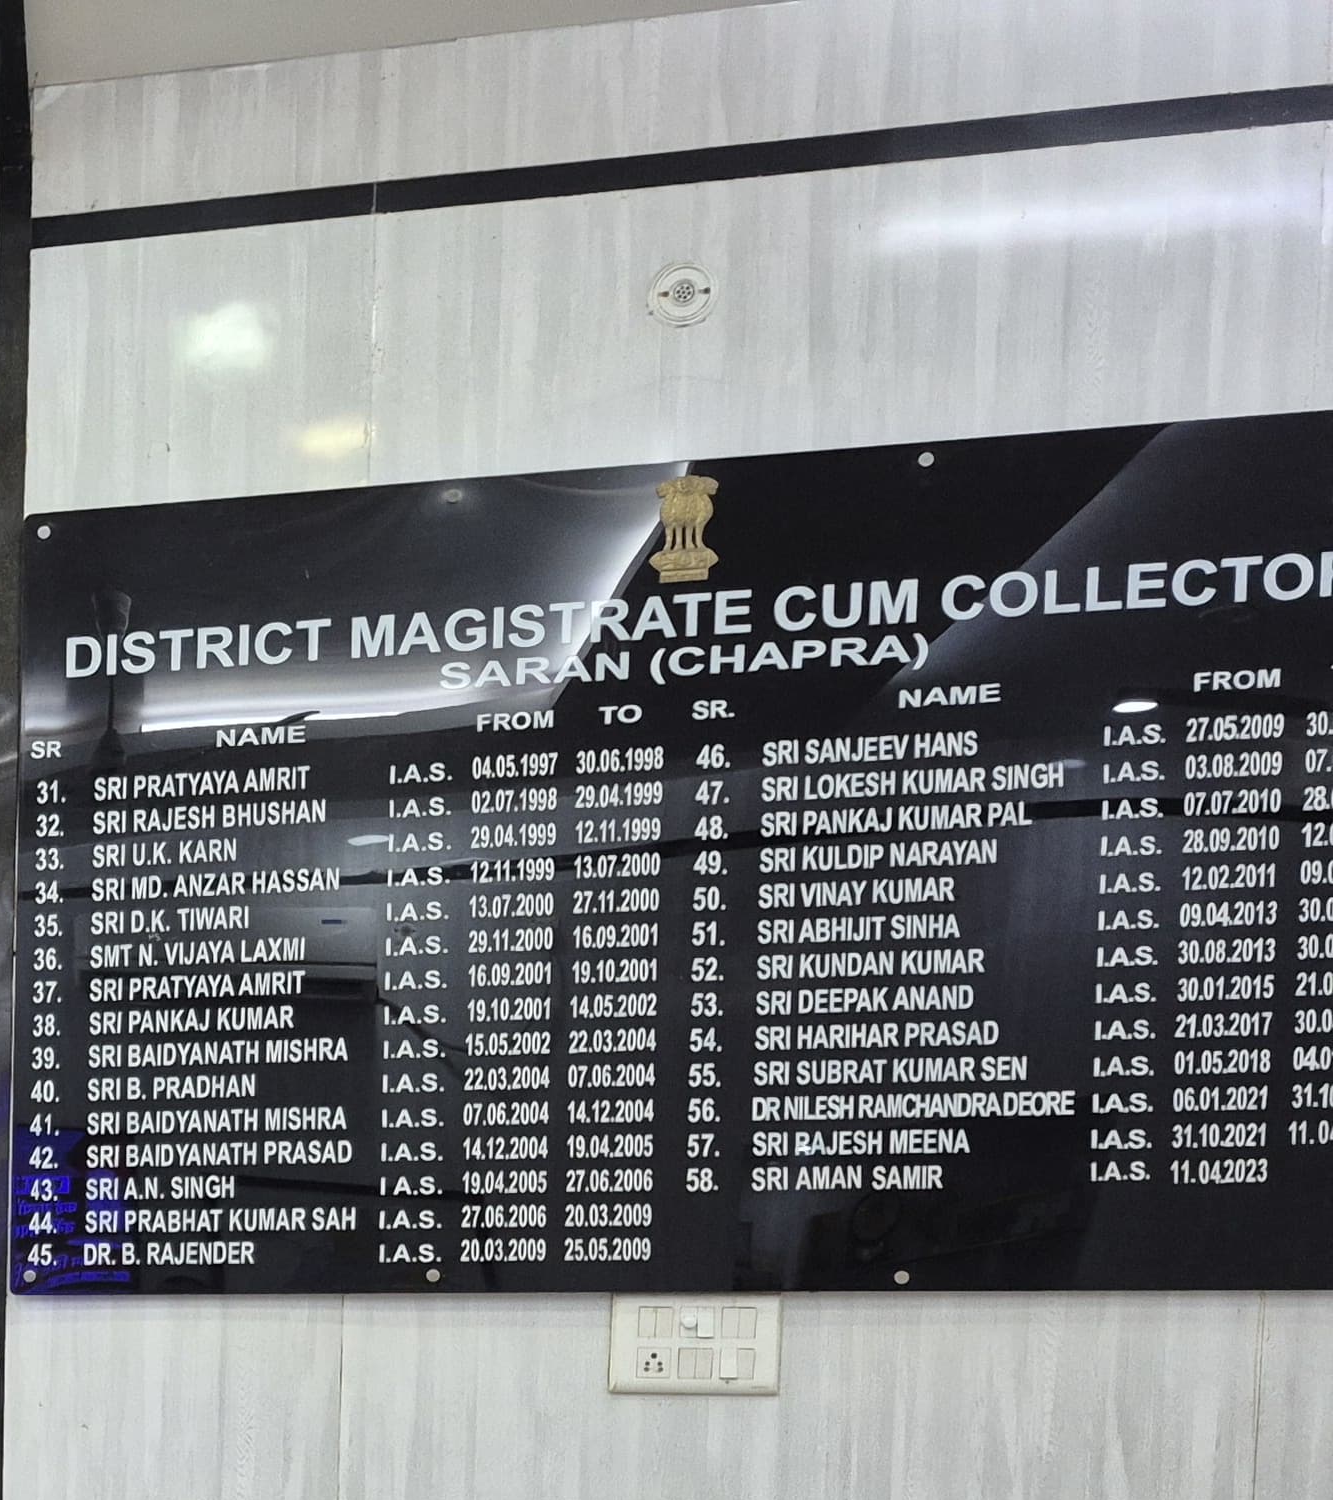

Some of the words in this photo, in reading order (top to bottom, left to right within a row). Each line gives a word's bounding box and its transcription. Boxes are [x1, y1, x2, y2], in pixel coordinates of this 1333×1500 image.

[65, 618, 331, 678] DISTRICT
[351, 589, 752, 660] MAGISTRATE
[774, 578, 918, 632] CUM
[941, 551, 1333, 620] COLLECTO
[440, 651, 630, 690] SARAN
[649, 632, 929, 685] (CHAPRA)
[31, 741, 62, 760] SR
[216, 724, 307, 748] NAME
[476, 709, 555, 732] FROM
[598, 704, 643, 725] TO
[692, 700, 735, 720] SR.
[898, 682, 1001, 710] NAME
[1193, 668, 1281, 692] FROM
[36, 814, 63, 837] 32.
[93, 810, 126, 834] SRI
[133, 805, 215, 832] RAJESH
[223, 799, 326, 828] BHUSHAN
[389, 797, 451, 818] I.A.S.
[472, 787, 557, 813] 02.07.1998
[575, 781, 662, 808] 29.04.1999
[35, 880, 63, 904] 34.
[92, 877, 125, 901] SRI
[132, 875, 167, 899] MD.
[173, 872, 245, 897] ANZAR
[253, 868, 339, 894] HASSAN
[388, 866, 449, 886] I.A.S.
[471, 858, 554, 883] 12.11.1999
[574, 852, 661, 878] 13.07.2000
[693, 886, 726, 911] 50.
[758, 883, 795, 909] SRI
[800, 880, 867, 907] VINAY
[872, 877, 955, 904] KUMAR
[1099, 872, 1161, 894] I.A.S.
[1182, 863, 1275, 890] 12.02.2011
[691, 957, 723, 982] 52.
[757, 955, 793, 980] SRI
[799, 951, 894, 978] KUNDAN
[901, 949, 985, 975] KUMAR
[1097, 946, 1158, 967] I.A.S.
[1178, 937, 1275, 964] 30.08.2013
[33, 1014, 60, 1037] 38.
[90, 1011, 122, 1035] SRI
[129, 1008, 210, 1033] PANKAJ
[217, 1005, 294, 1030] KUMAR
[384, 1005, 446, 1025] I.A.S.
[468, 997, 551, 1022] 19.10.2001
[570, 993, 657, 1018] 14.05.2002
[689, 1063, 721, 1087] 55.
[754, 1061, 790, 1086] SRI
[796, 1059, 887, 1085] SUBRAT
[893, 1057, 975, 1082] KUMAR
[981, 1056, 1027, 1081] SEN
[1093, 1056, 1154, 1077] I.A.S.
[1175, 1049, 1270, 1074] 01.05.2018
[30, 1114, 59, 1136] 41.
[87, 1112, 120, 1135] SRI
[127, 1108, 258, 1134] BAIDYANATH
[265, 1106, 347, 1131] MISHRA
[382, 1108, 443, 1128] I.A.S.
[463, 1101, 549, 1126] 07.06.2004
[568, 1099, 654, 1124] 14.12.2004
